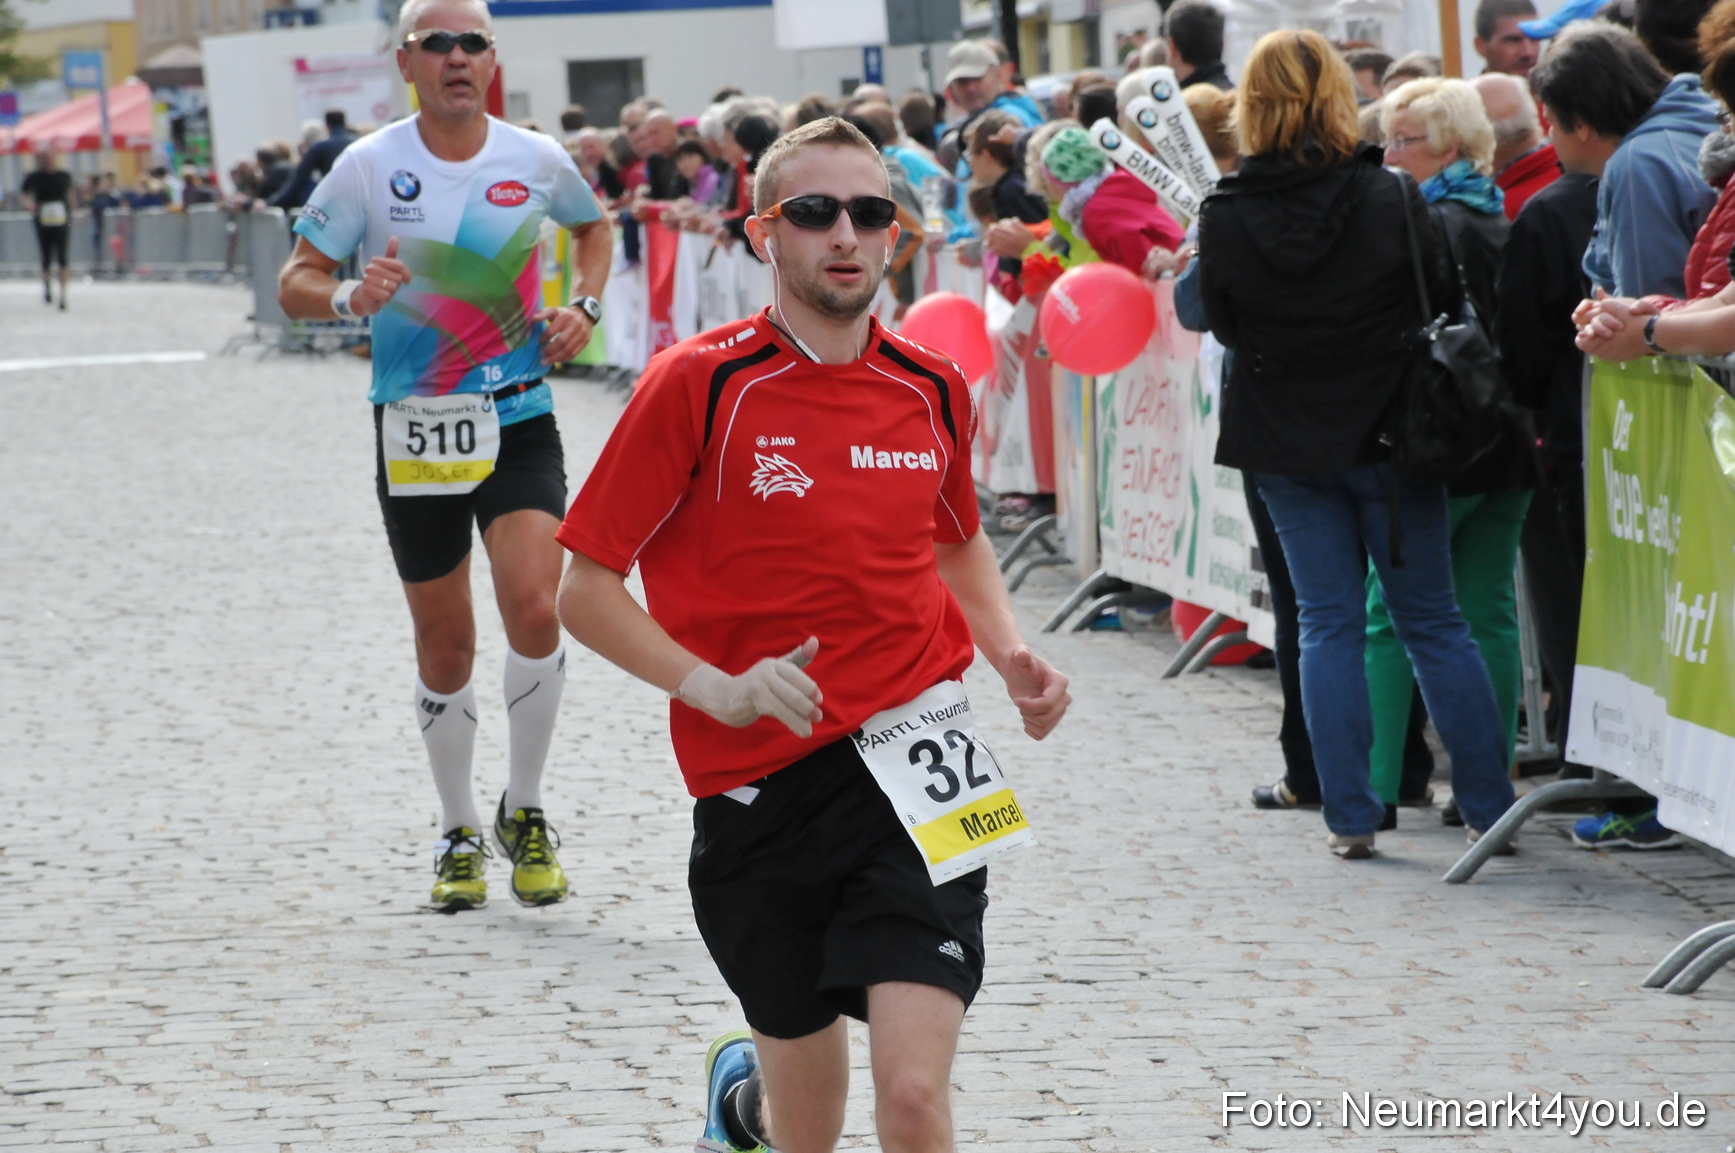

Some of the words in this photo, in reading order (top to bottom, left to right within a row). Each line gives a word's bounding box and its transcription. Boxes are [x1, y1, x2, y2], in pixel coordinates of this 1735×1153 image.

[1126, 150, 1173, 192] BMW
[390, 206, 424, 216] PARTL
[481, 364, 503, 382] 16
[388, 402, 420, 416] PARTL
[421, 404, 477, 417] Neumarkt
[406, 419, 476, 456] 510
[1612, 399, 1633, 451] Der
[770, 436, 796, 447] JAKO
[410, 463, 476, 481] JOSEF
[850, 445, 939, 472] Marcel
[857, 720, 921, 753] PARTL
[908, 729, 1004, 804] 32
[960, 797, 1024, 842] Marcel
